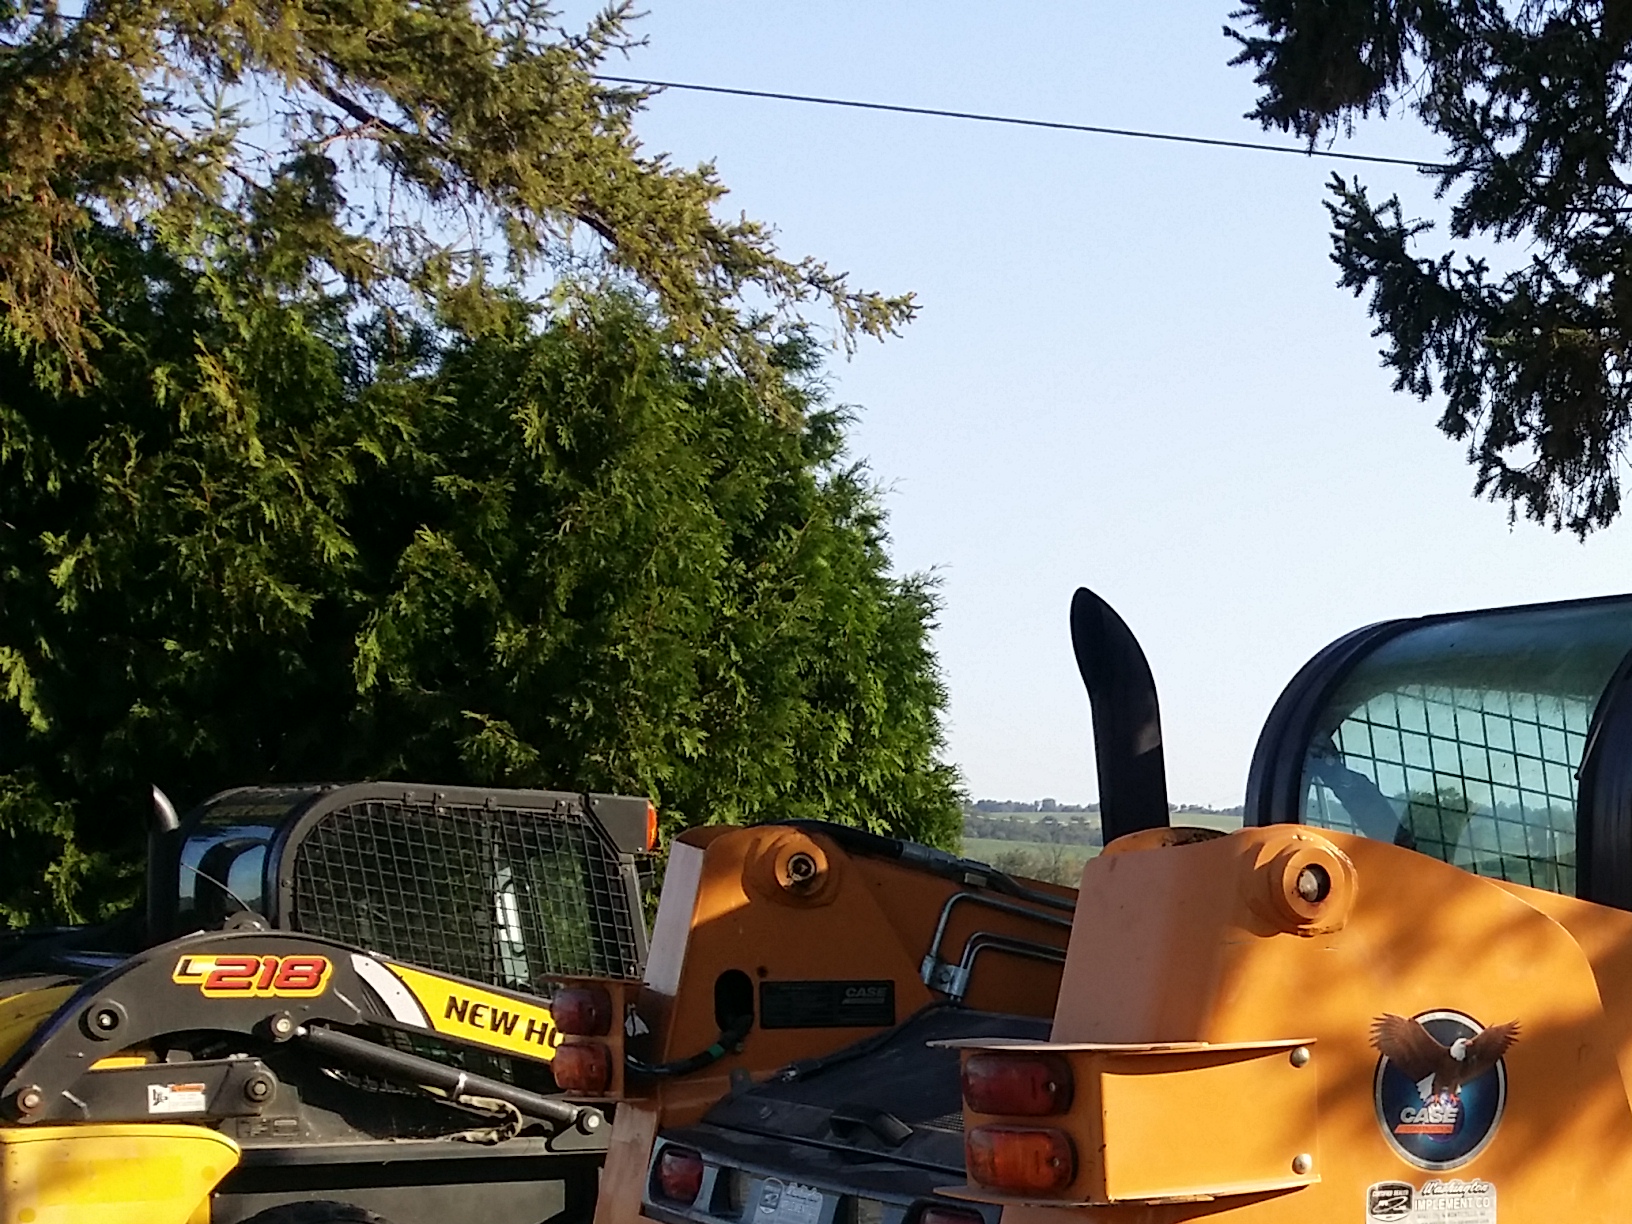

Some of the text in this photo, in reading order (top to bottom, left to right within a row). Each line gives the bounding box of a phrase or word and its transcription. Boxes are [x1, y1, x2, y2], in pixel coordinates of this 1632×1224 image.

[176, 957, 328, 992] L218
[845, 986, 889, 998] CASE
[444, 995, 520, 1036] NEW
[1400, 1106, 1459, 1124] CASE
[1414, 1197, 1473, 1211] IMPLEMENT
[1475, 1196, 1490, 1209] CO
